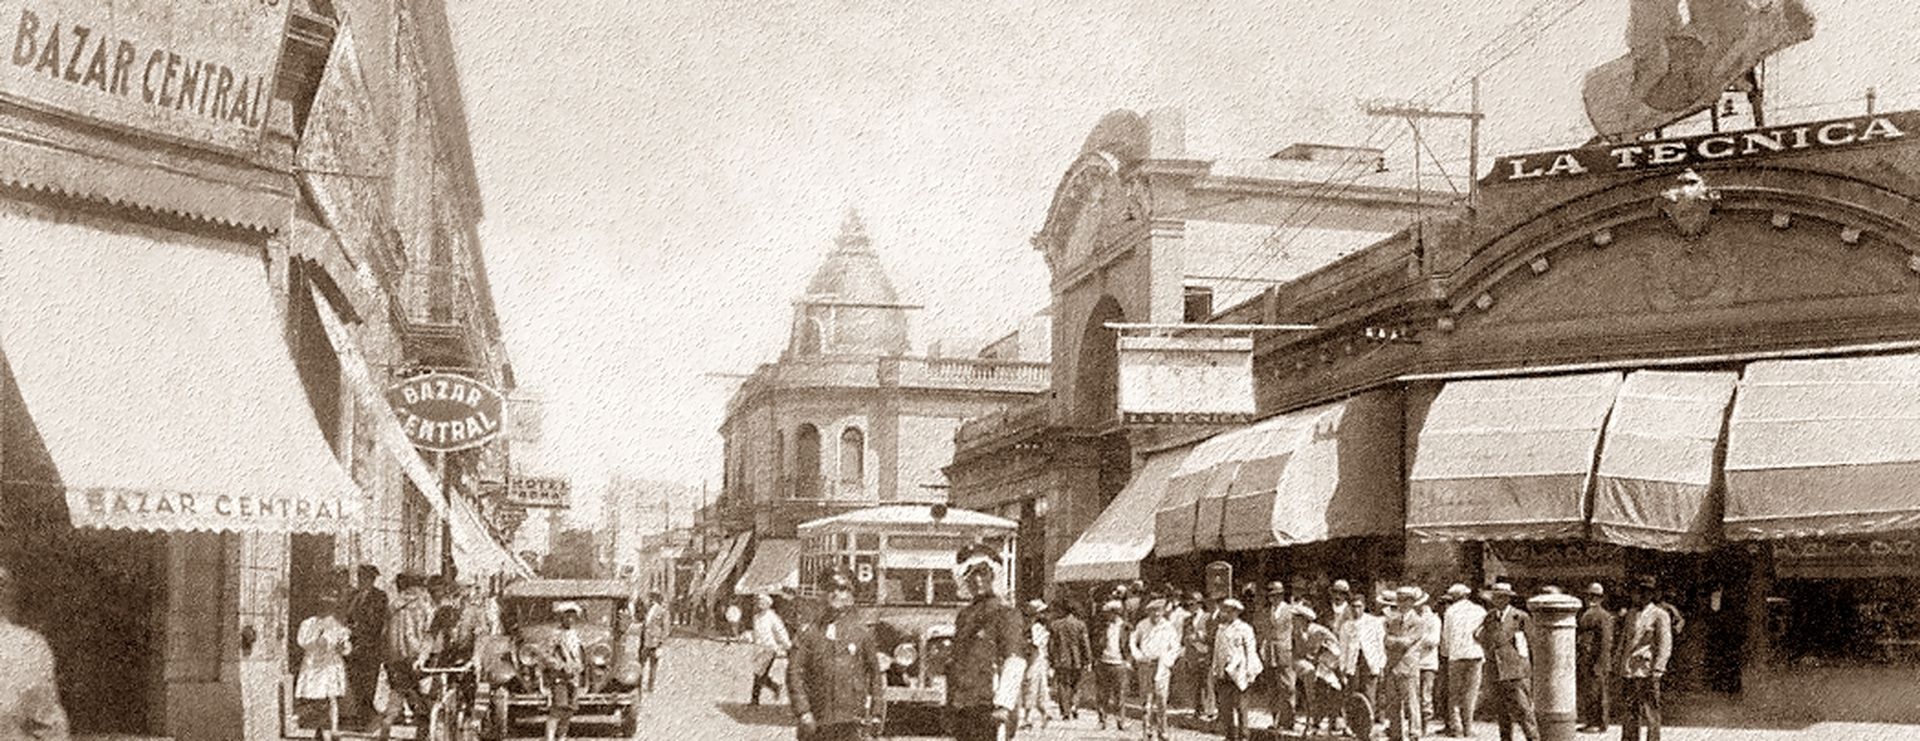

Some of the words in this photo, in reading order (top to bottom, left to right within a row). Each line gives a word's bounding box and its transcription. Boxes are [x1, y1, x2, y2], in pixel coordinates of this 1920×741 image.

[12, 8, 136, 96] BAZAR
[141, 49, 264, 127] CENTRAL
[1508, 153, 1588, 179] LA
[1610, 116, 1906, 168] TECNICA
[401, 381, 481, 407] BAZAR
[400, 409, 497, 443] ENTRAL
[87, 488, 198, 515] BAZAR
[214, 494, 349, 520] CENTRAL
[858, 563, 873, 582] B
